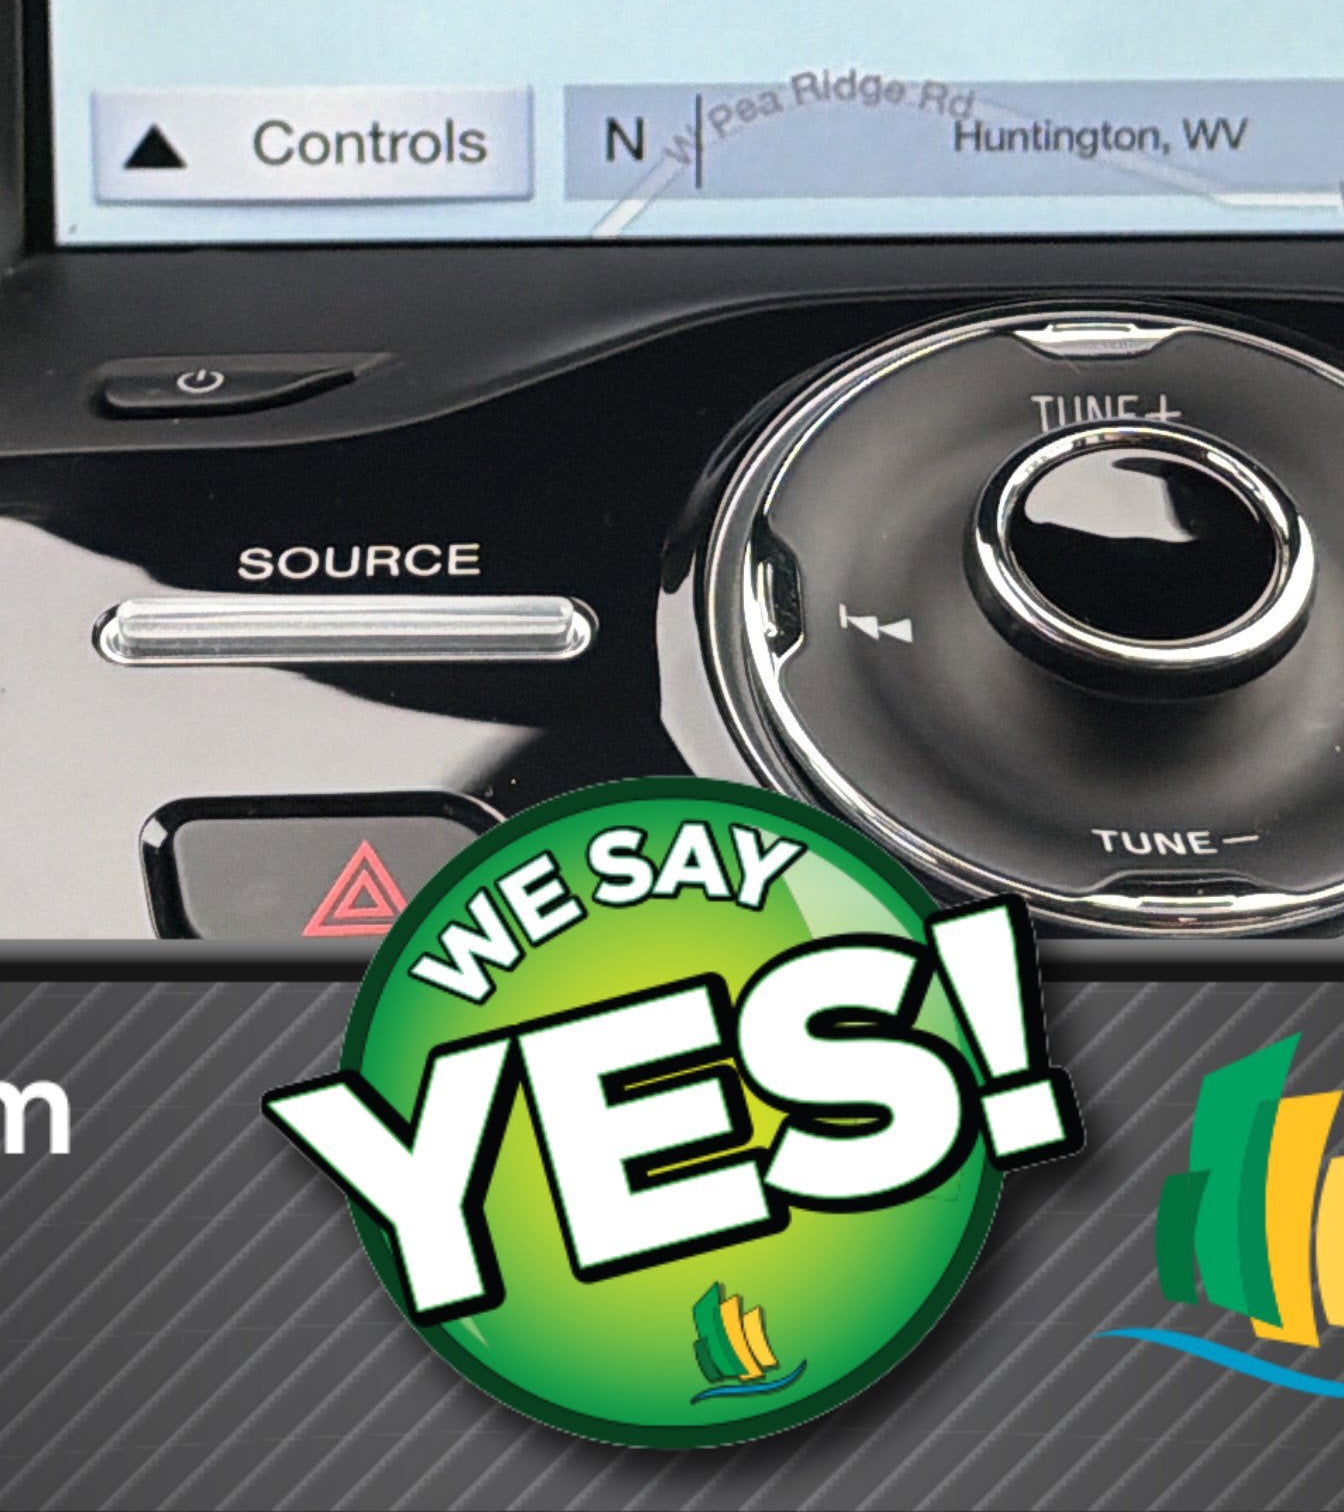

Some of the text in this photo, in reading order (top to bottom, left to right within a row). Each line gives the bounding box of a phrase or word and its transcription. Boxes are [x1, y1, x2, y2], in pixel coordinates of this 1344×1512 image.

[708, 90, 785, 140] Pea
[790, 67, 907, 108] Ridge
[918, 79, 977, 121] Rd
[253, 118, 488, 166] Controls
[605, 115, 645, 163] N
[953, 117, 1250, 159] Huntington, WV
[237, 541, 482, 582] SOURCE
